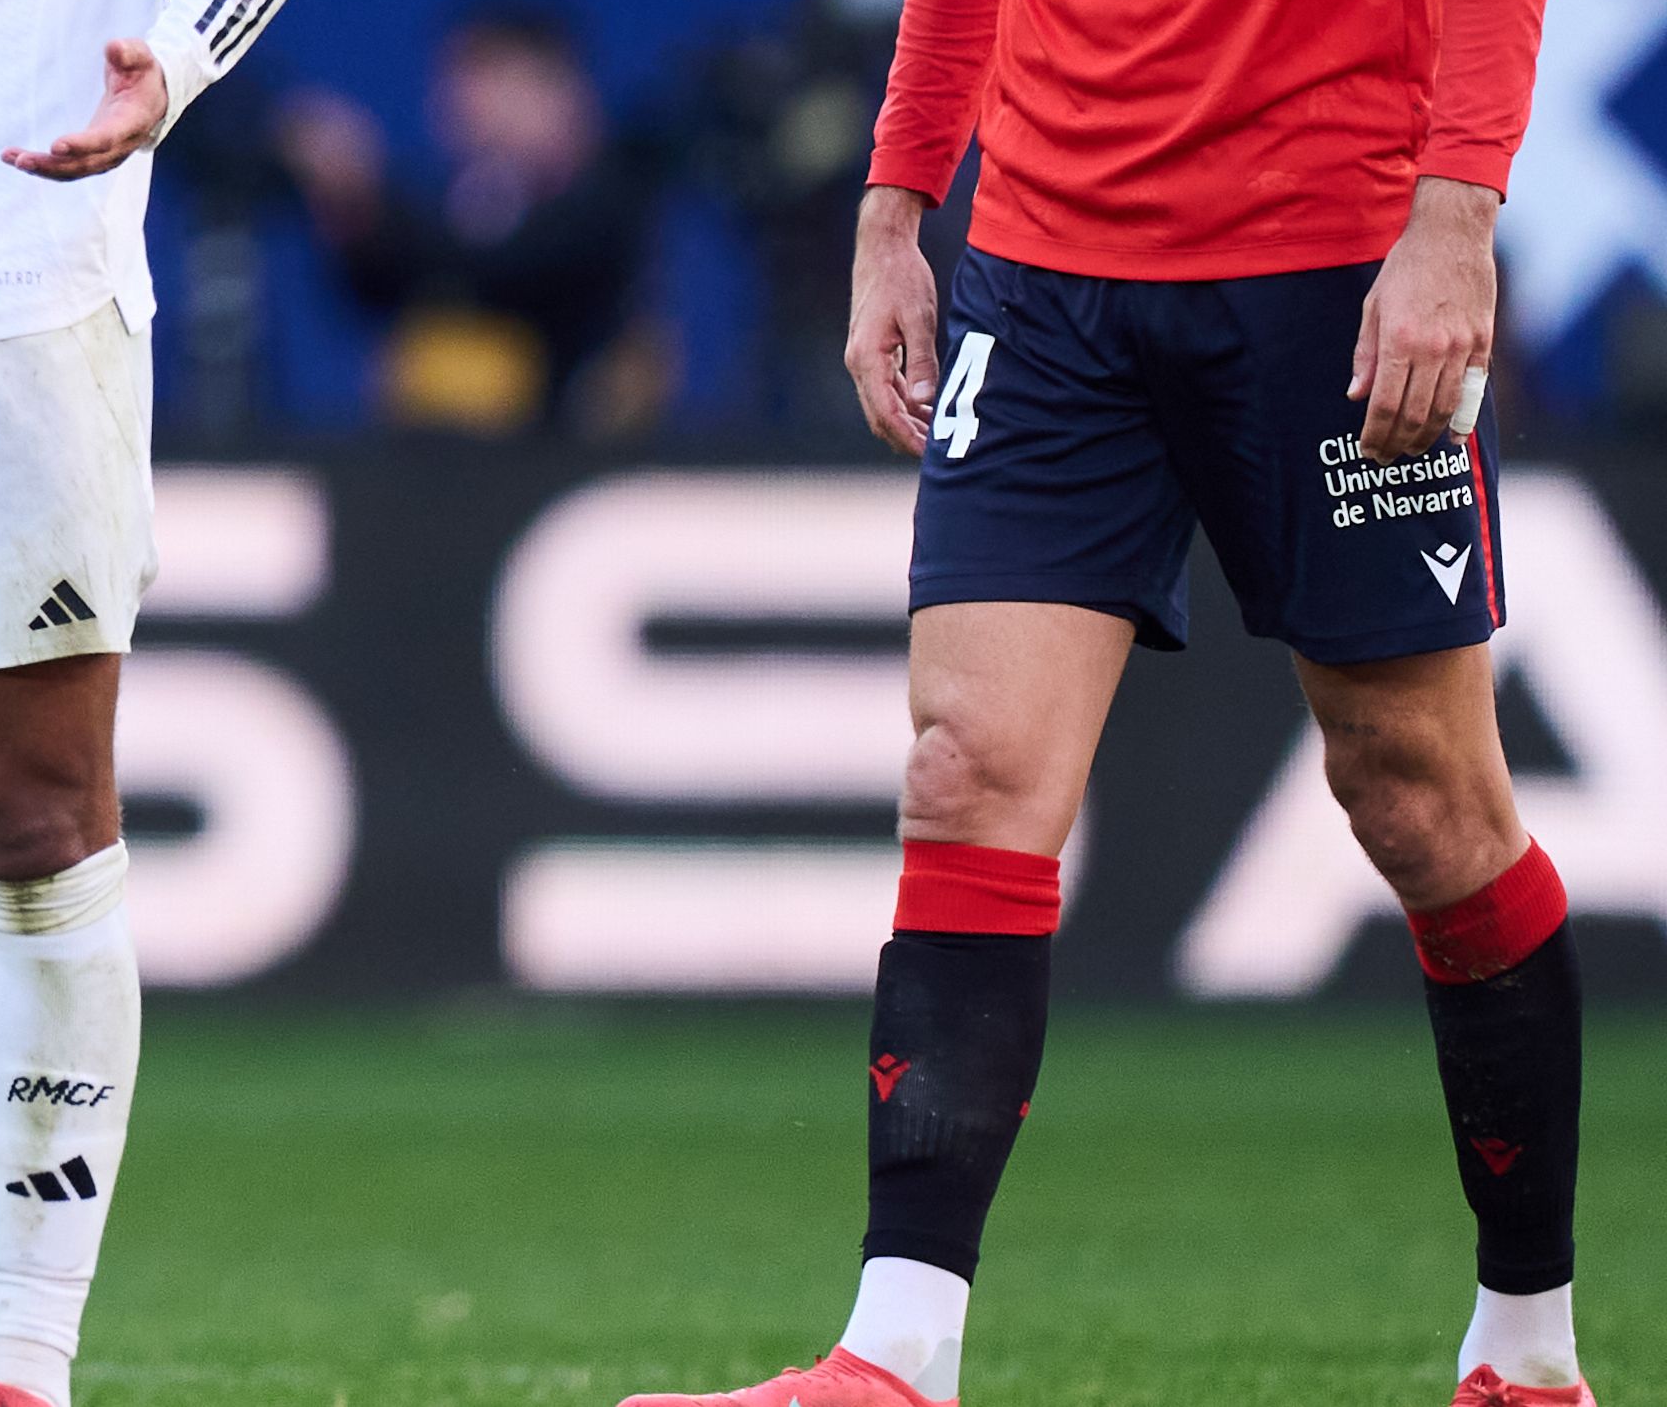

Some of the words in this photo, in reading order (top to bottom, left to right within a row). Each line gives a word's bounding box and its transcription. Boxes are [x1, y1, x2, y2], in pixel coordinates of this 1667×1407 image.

[932, 331, 995, 458] 4
[1324, 443, 1471, 497] Universidad
[1332, 500, 1366, 528] de
[1371, 484, 1473, 520] Navarra
[7, 1076, 115, 1107] RMCF
